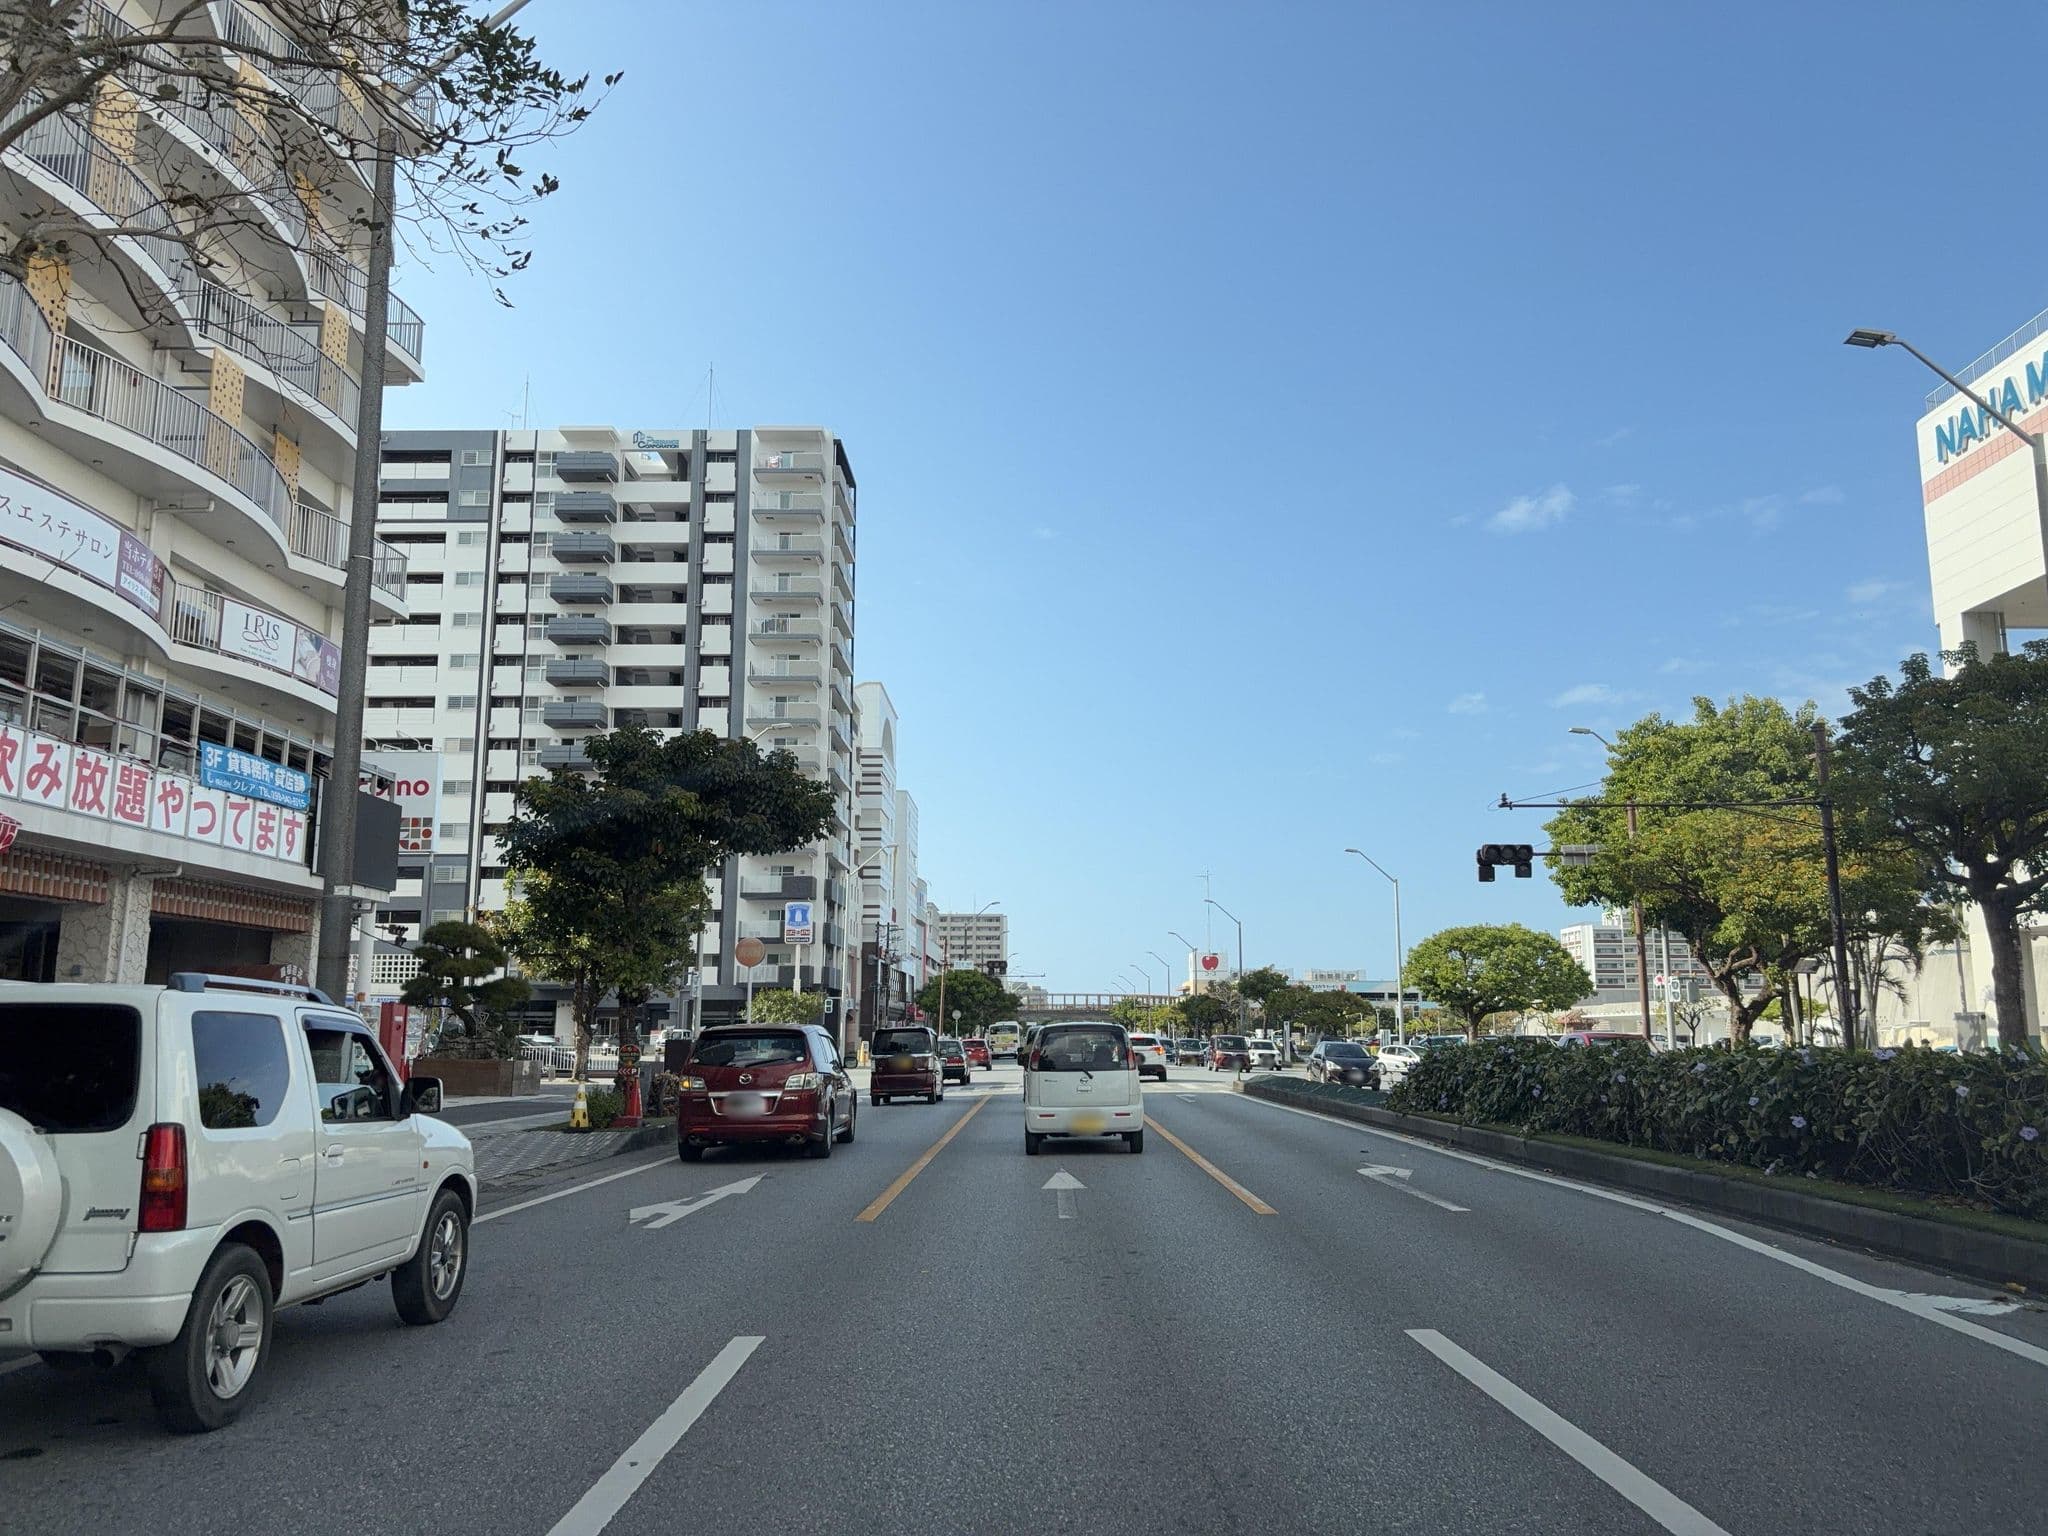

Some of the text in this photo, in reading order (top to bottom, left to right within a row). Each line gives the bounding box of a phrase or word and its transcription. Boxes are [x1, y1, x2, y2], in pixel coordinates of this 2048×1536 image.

[1935, 376, 2026, 465] NAHA
[0, 496, 113, 560] スエステサロン
[242, 612, 280, 651] IRIS
[205, 746, 223, 768] 3F
